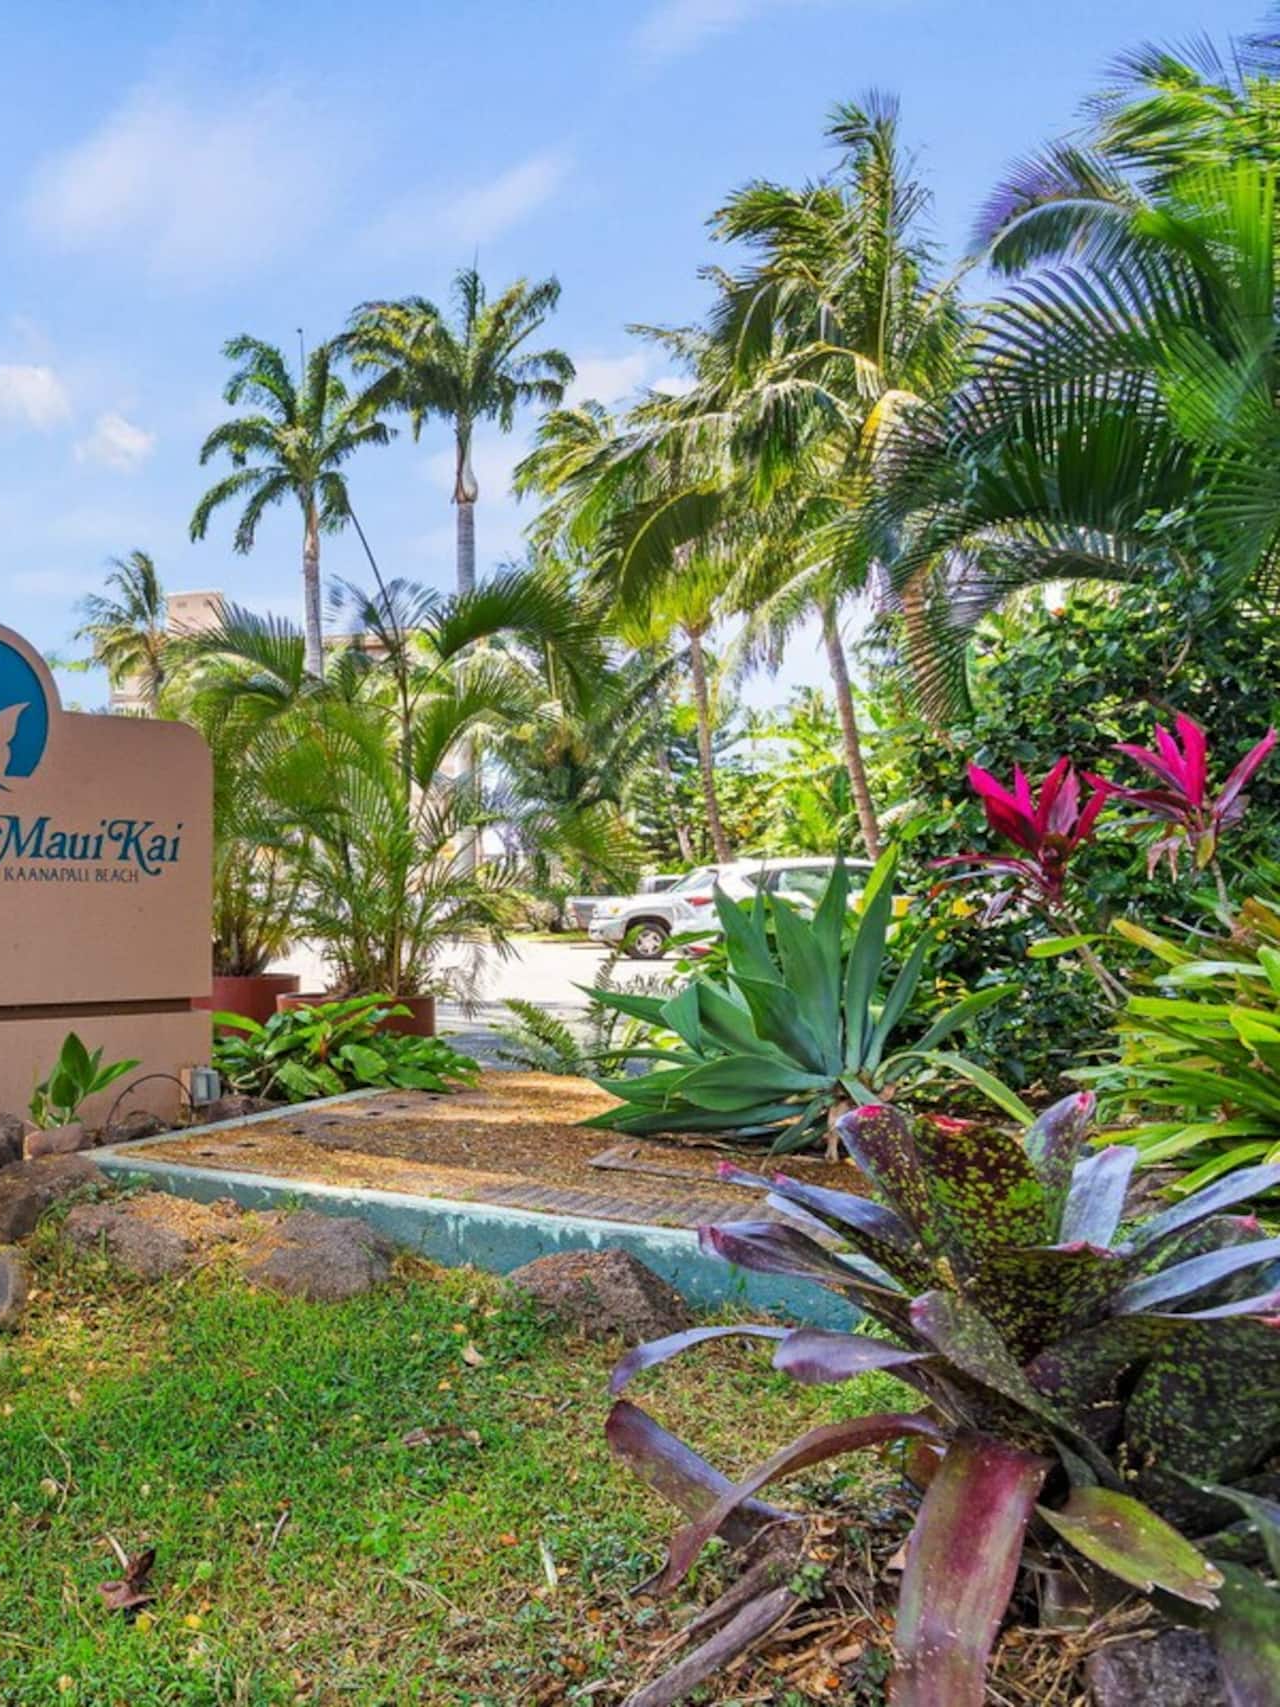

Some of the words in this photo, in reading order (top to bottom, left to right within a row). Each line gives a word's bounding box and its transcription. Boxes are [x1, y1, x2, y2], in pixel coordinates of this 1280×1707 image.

[108, 819, 183, 876] Kai
[3, 866, 89, 882] KAANAPALI
[95, 868, 139, 883] BEACH
